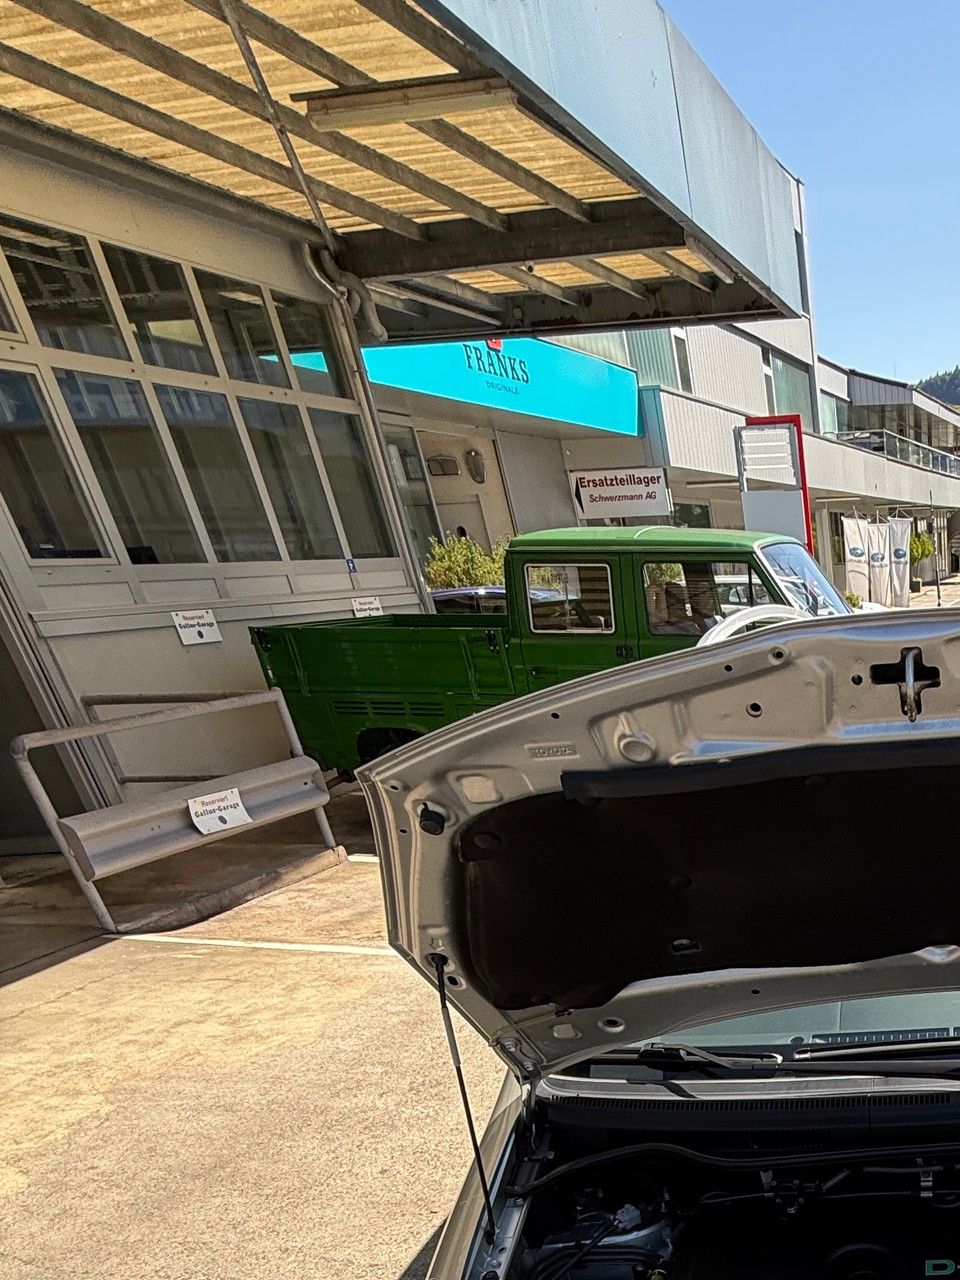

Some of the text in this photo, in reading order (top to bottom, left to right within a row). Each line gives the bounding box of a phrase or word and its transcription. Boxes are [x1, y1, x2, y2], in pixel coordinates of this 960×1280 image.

[463, 343, 529, 384] FRANKS
[579, 474, 661, 488] Ersatzteillager
[589, 491, 656, 503] Schwerzmann AG
[200, 795, 230, 808] Reserviert
[194, 802, 240, 818] Gallus-Garage
